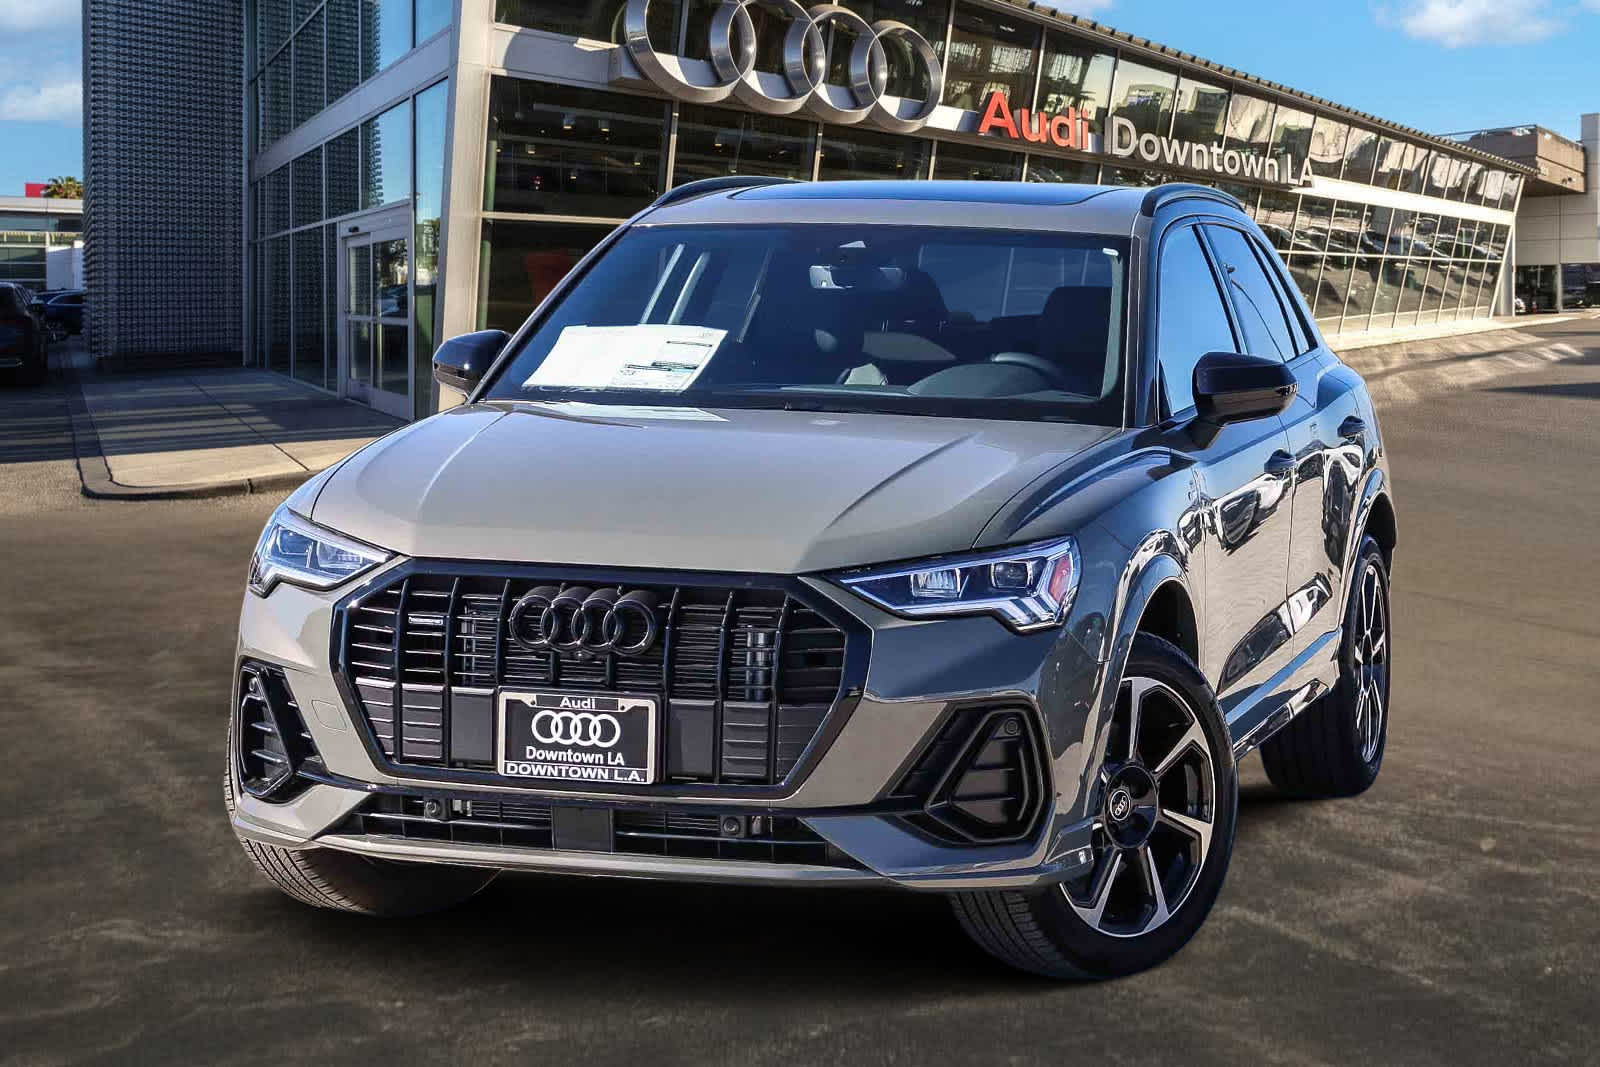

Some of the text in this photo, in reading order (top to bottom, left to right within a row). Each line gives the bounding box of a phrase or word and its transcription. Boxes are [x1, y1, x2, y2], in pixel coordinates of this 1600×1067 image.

[978, 91, 1314, 188] Audi Downtown LA
[559, 696, 596, 710] Audi
[526, 745, 625, 766] Downtown LA
[506, 762, 646, 782] DOWNTOWN L.A.
